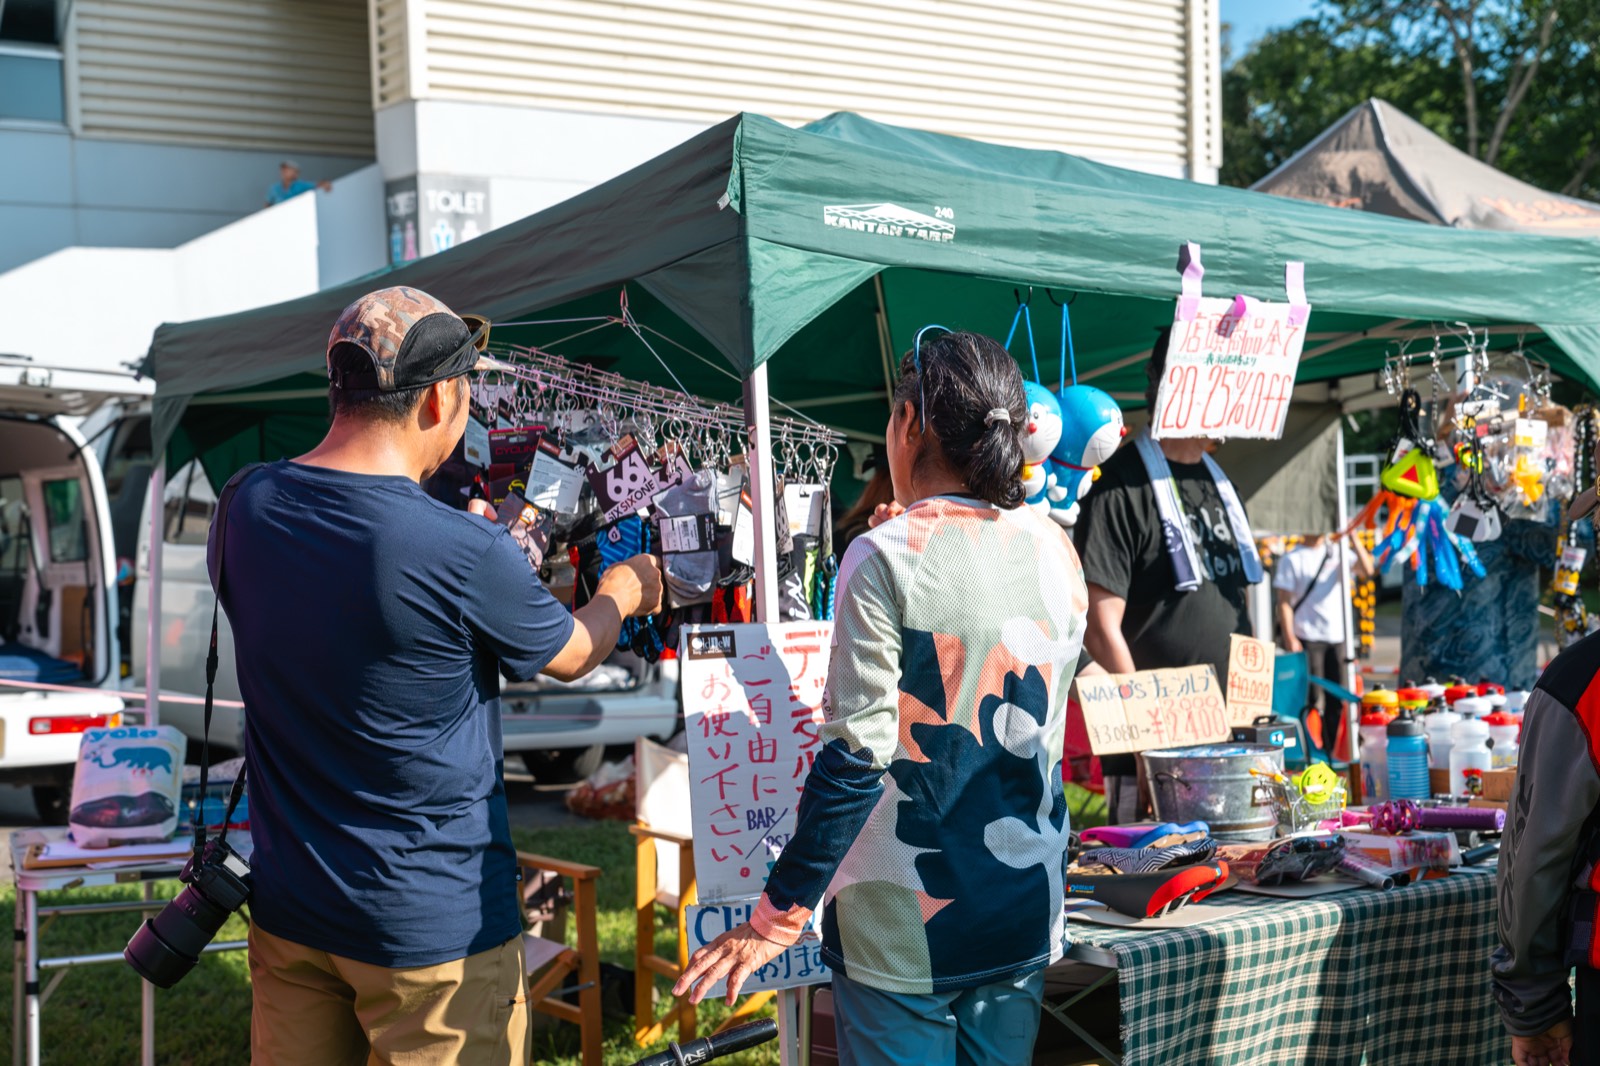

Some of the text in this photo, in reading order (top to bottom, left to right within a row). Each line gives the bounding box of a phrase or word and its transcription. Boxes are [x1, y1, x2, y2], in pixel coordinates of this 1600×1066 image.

[426, 190, 485, 214] TOILET
[934, 206, 954, 220] 240
[824, 214, 903, 237] KANTAN
